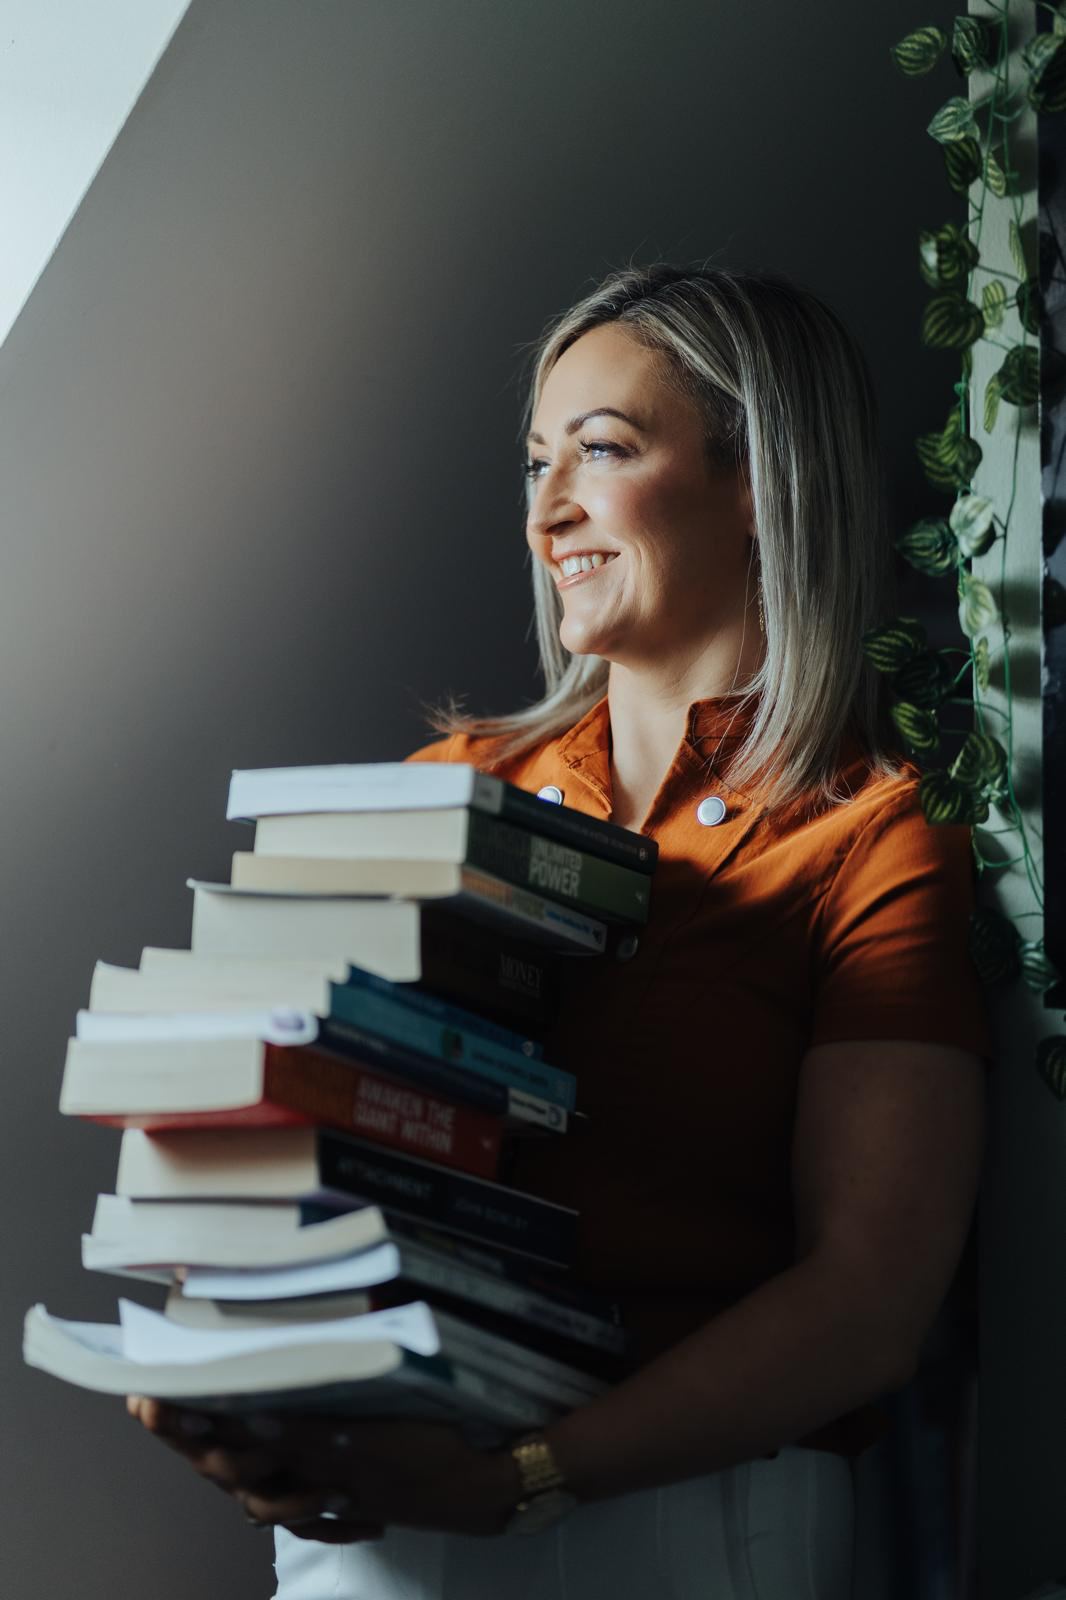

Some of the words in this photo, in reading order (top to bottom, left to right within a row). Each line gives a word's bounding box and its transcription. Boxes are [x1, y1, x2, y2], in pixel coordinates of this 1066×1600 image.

[528, 858, 581, 898] POWER
[500, 951, 544, 989] MONEY
[427, 1102, 456, 1131] THE
